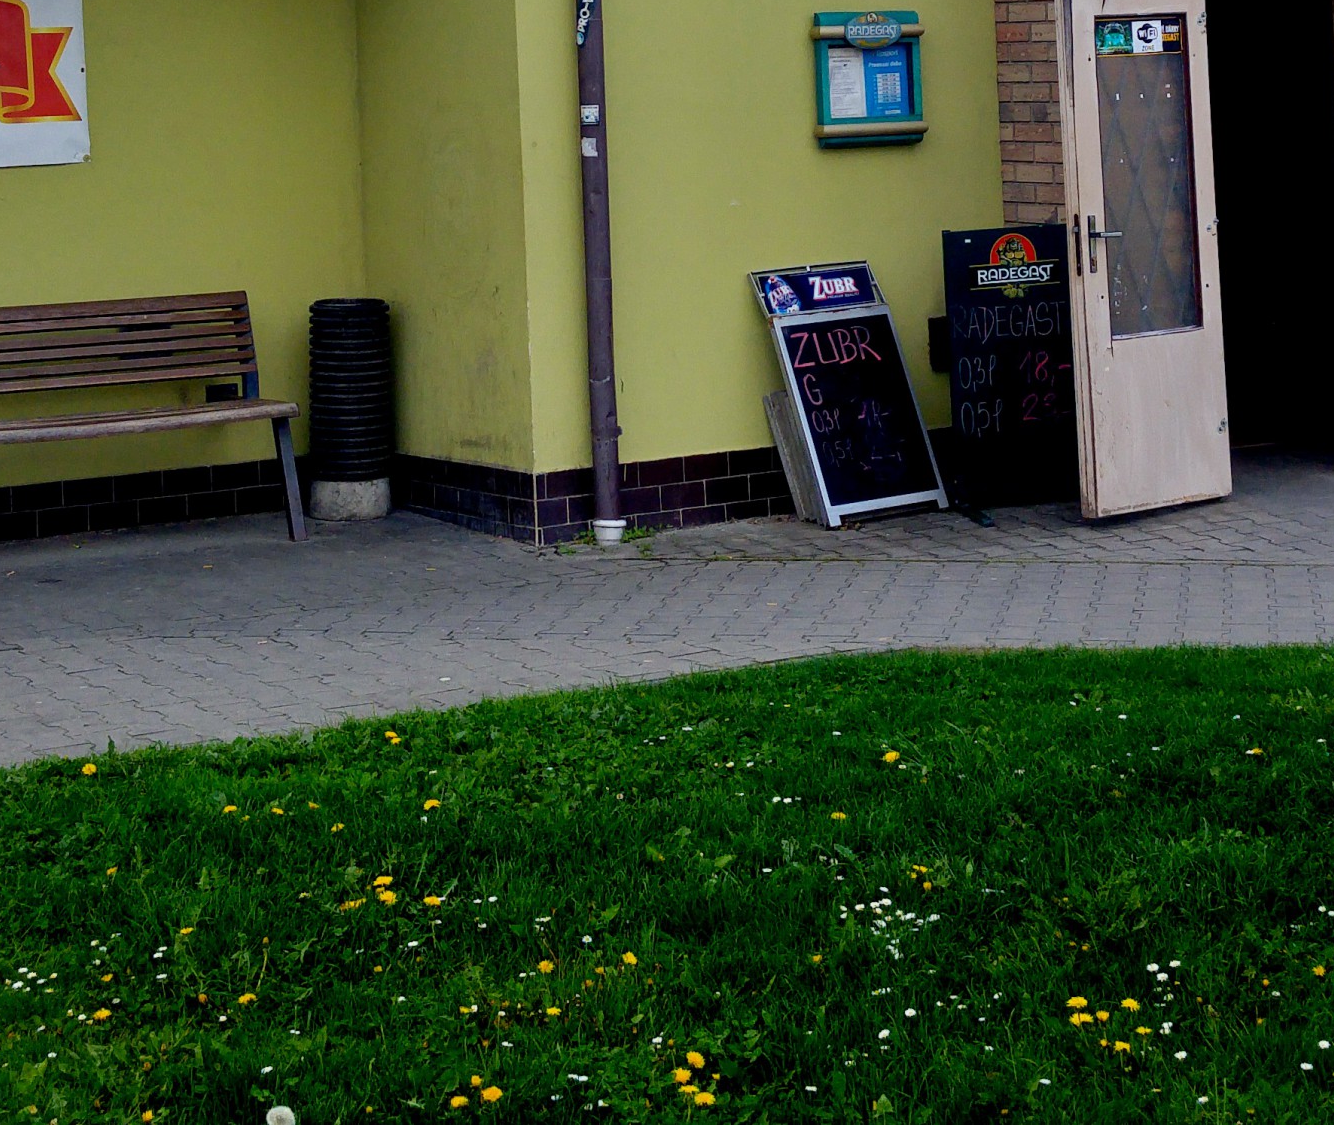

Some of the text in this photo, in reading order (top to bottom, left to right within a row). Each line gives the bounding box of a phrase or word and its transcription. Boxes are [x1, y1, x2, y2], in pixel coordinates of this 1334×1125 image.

[848, 24, 898, 39] RADEGAST
[977, 264, 1054, 286] RADEGAST
[808, 276, 859, 301] ZUBR
[950, 301, 1065, 344] RADEGAST
[790, 326, 882, 367] ZUBR
